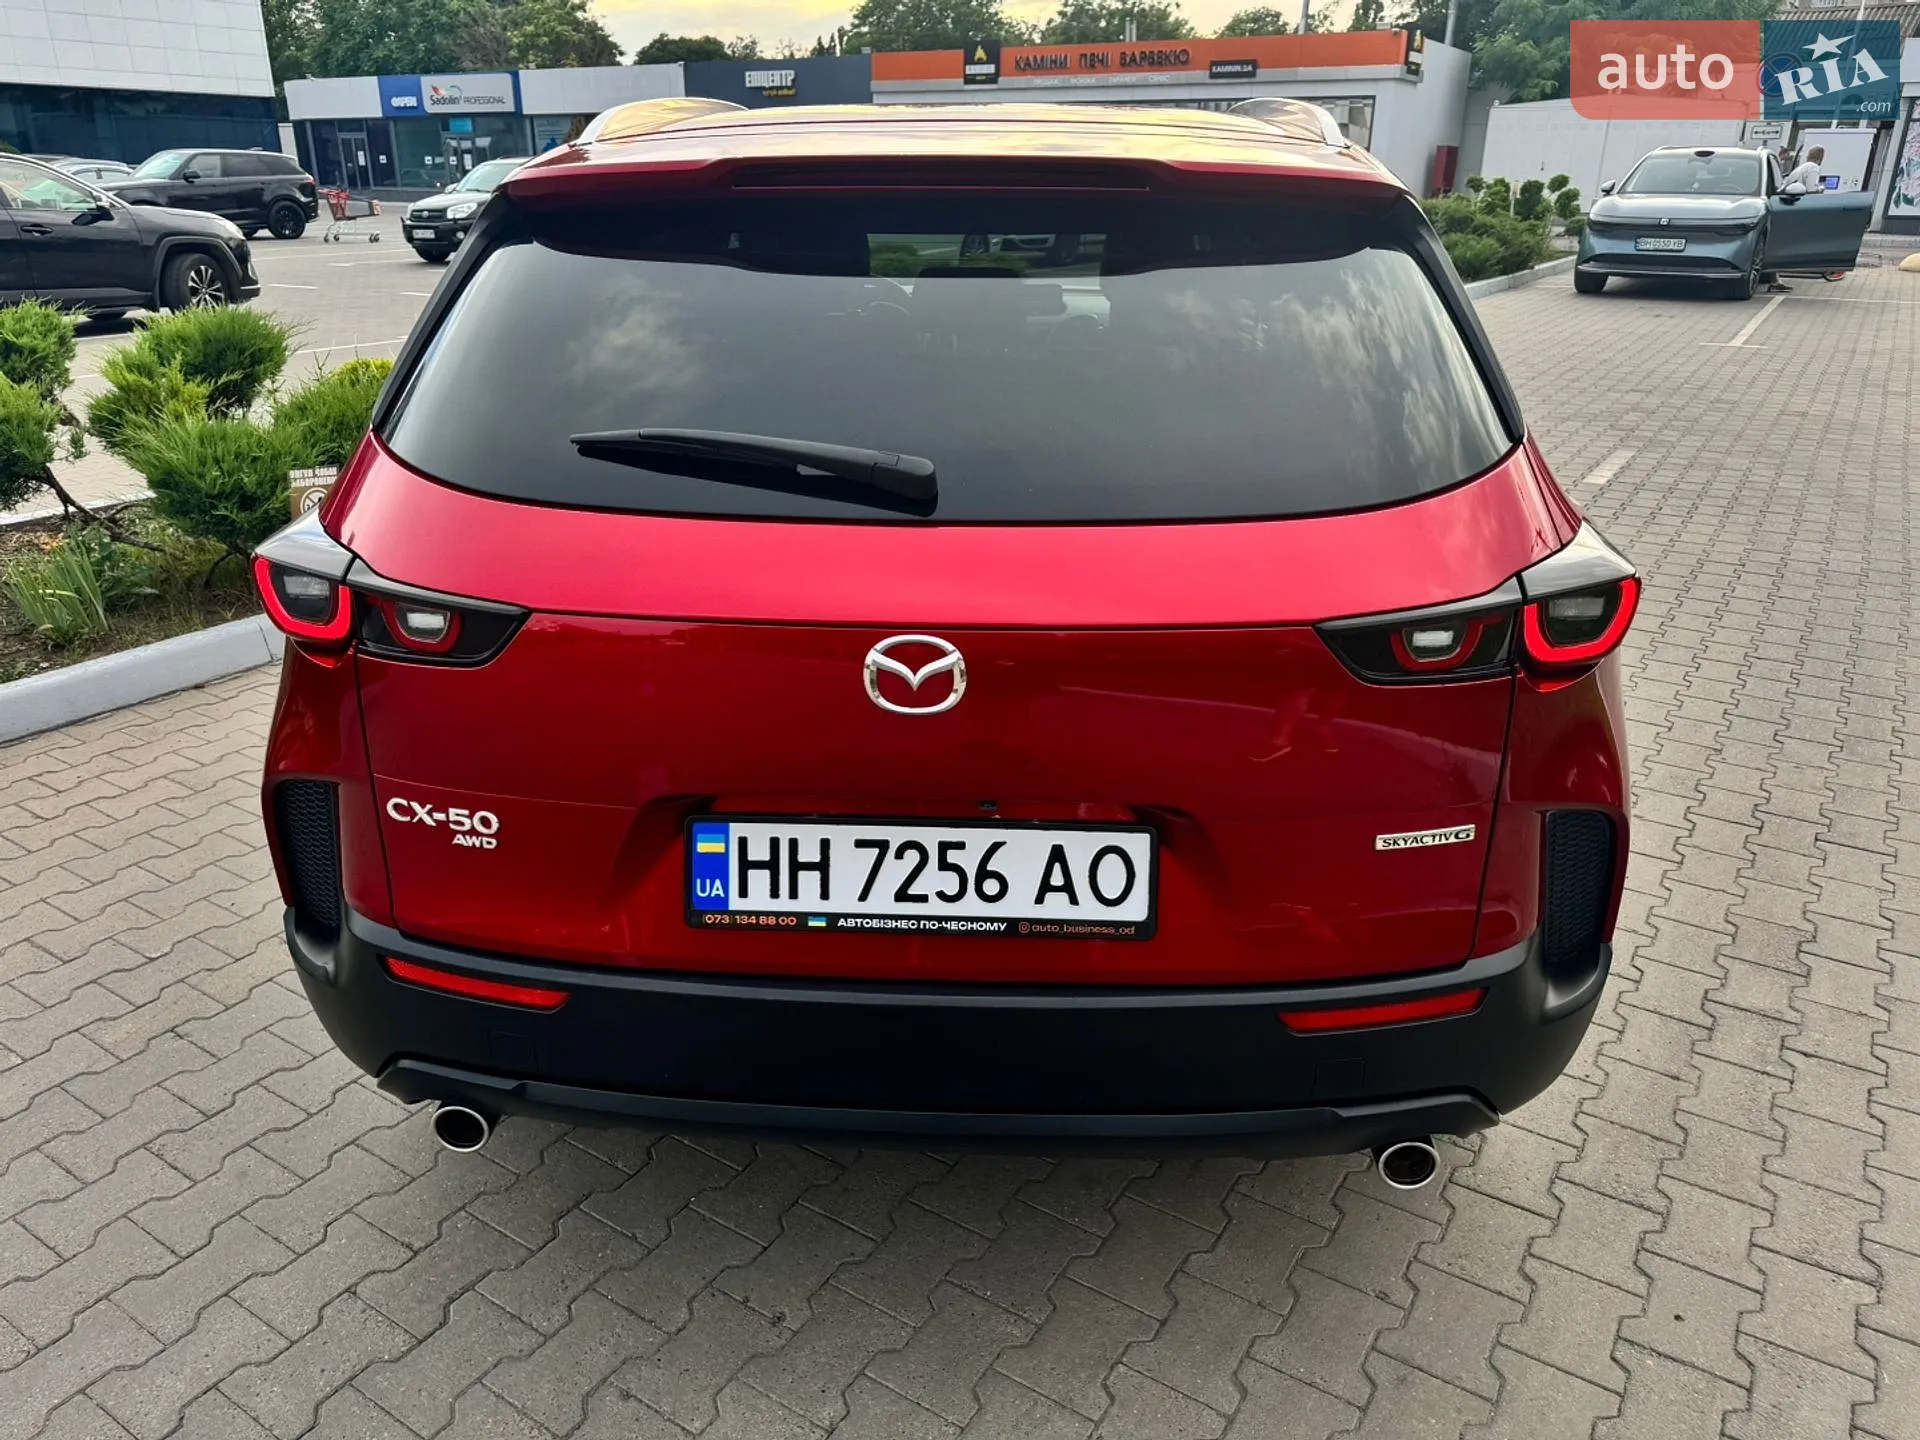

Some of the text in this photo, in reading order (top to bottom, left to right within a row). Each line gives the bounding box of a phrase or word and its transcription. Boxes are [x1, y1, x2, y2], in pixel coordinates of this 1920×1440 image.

[1015, 53, 1071, 71] КАМІНИ
[1079, 52, 1112, 68] ПЕЧІ
[463, 96, 507, 105] PROFESSIONAL
[387, 797, 500, 835] CX-50
[451, 833, 498, 850] AWD
[738, 835, 1137, 908] HH 7256 AO
[696, 879, 725, 897] UA
[735, 915, 757, 925] 134
[779, 916, 797, 926] 00
[837, 917, 1008, 932] АВТОБІЗНЕС ПО-ЧЕСНОМУ
[1031, 922, 1136, 936] auto_business_od
